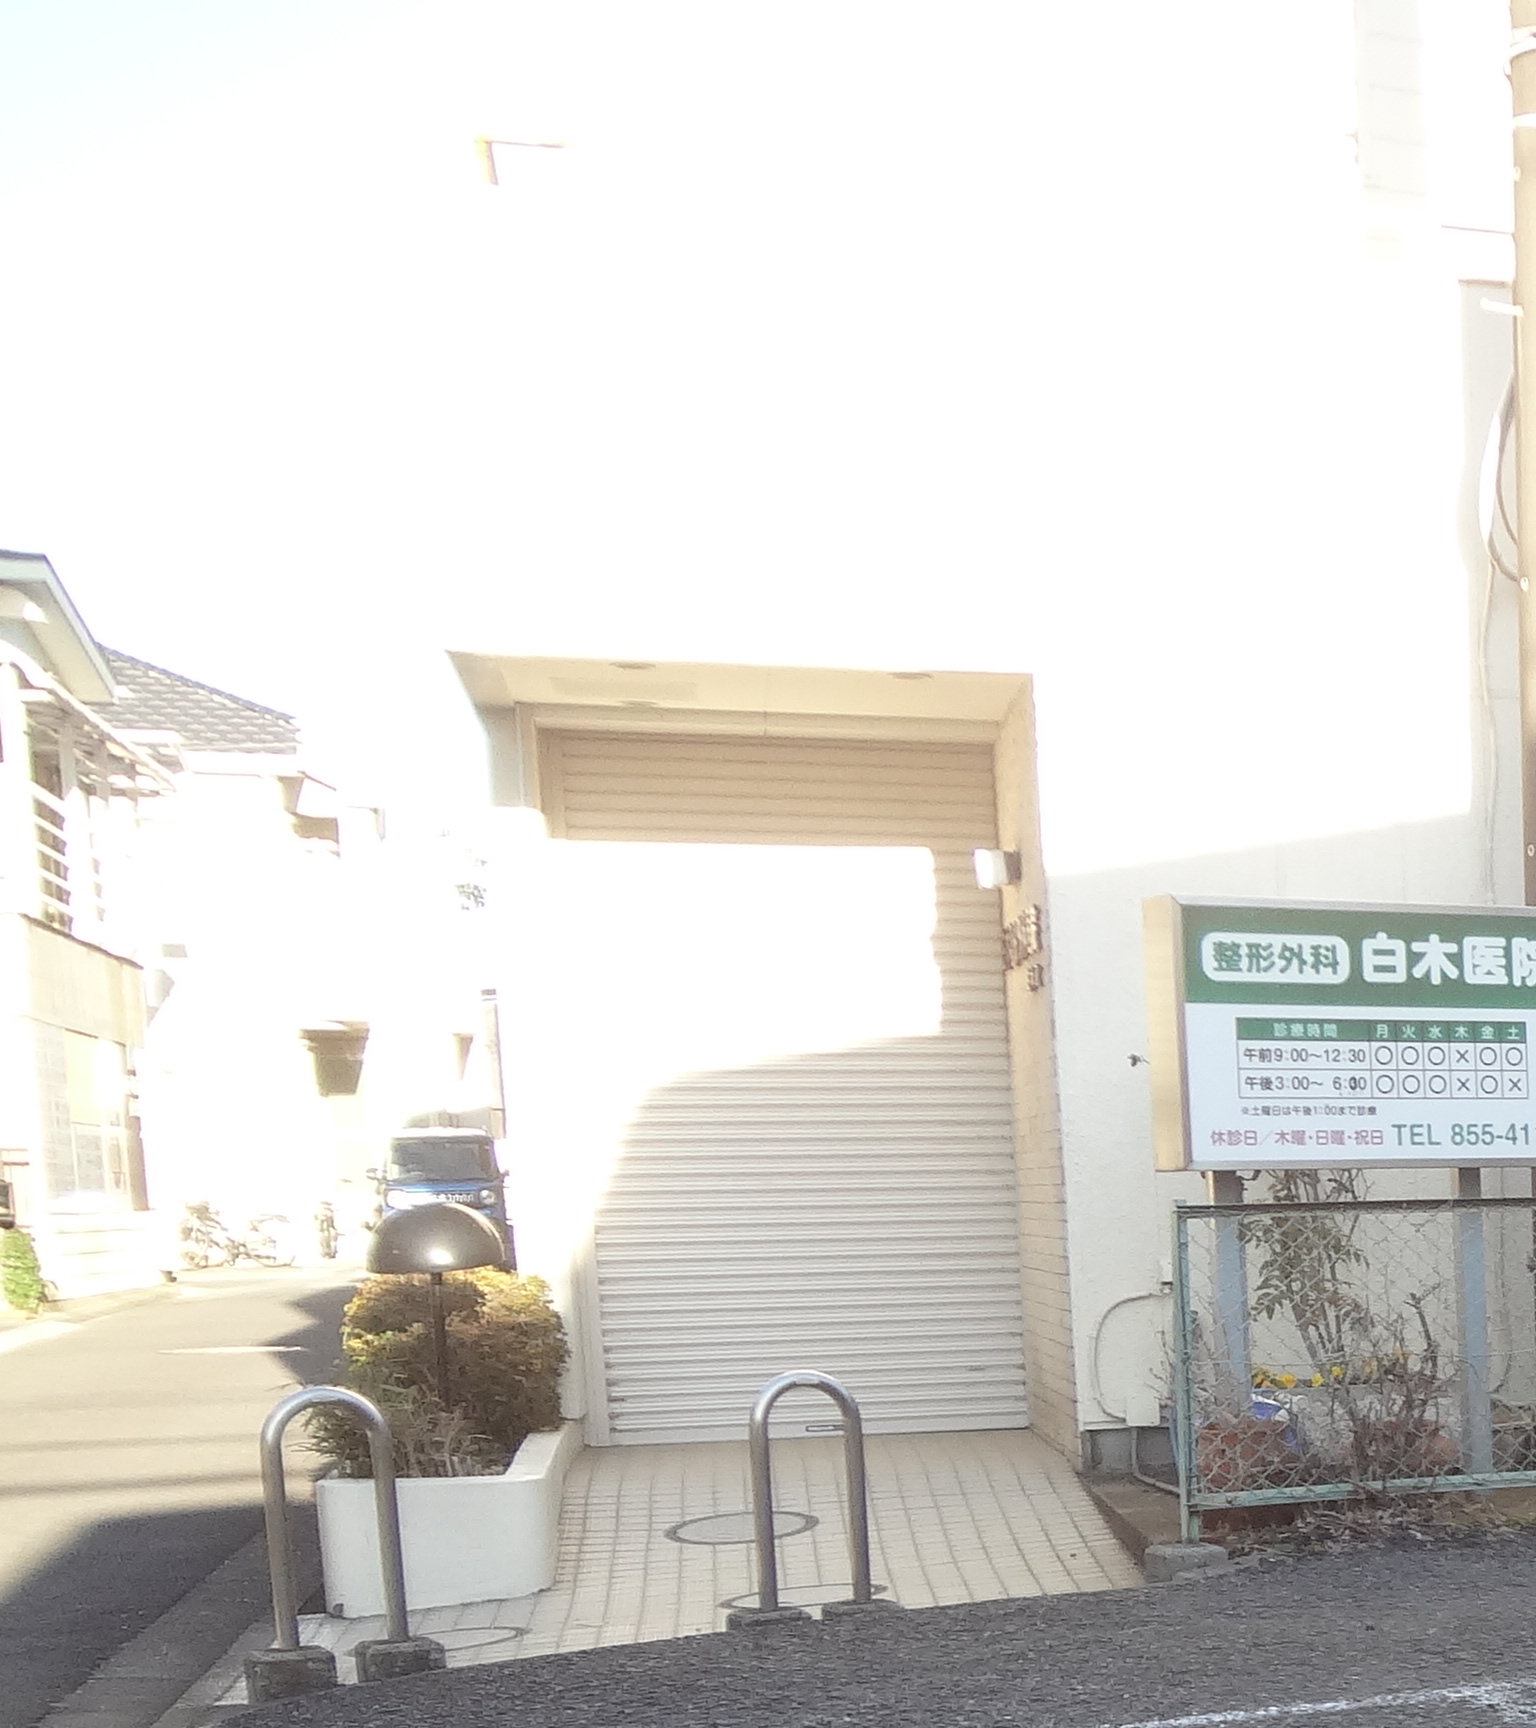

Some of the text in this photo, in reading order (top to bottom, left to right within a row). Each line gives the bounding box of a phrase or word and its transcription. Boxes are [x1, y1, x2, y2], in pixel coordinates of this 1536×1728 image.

[1212, 939, 1340, 975] 整形外科
[1273, 1022, 1520, 1039] 診療時間 月 火 水 木 金 土
[1391, 1122, 1442, 1146] TEL
